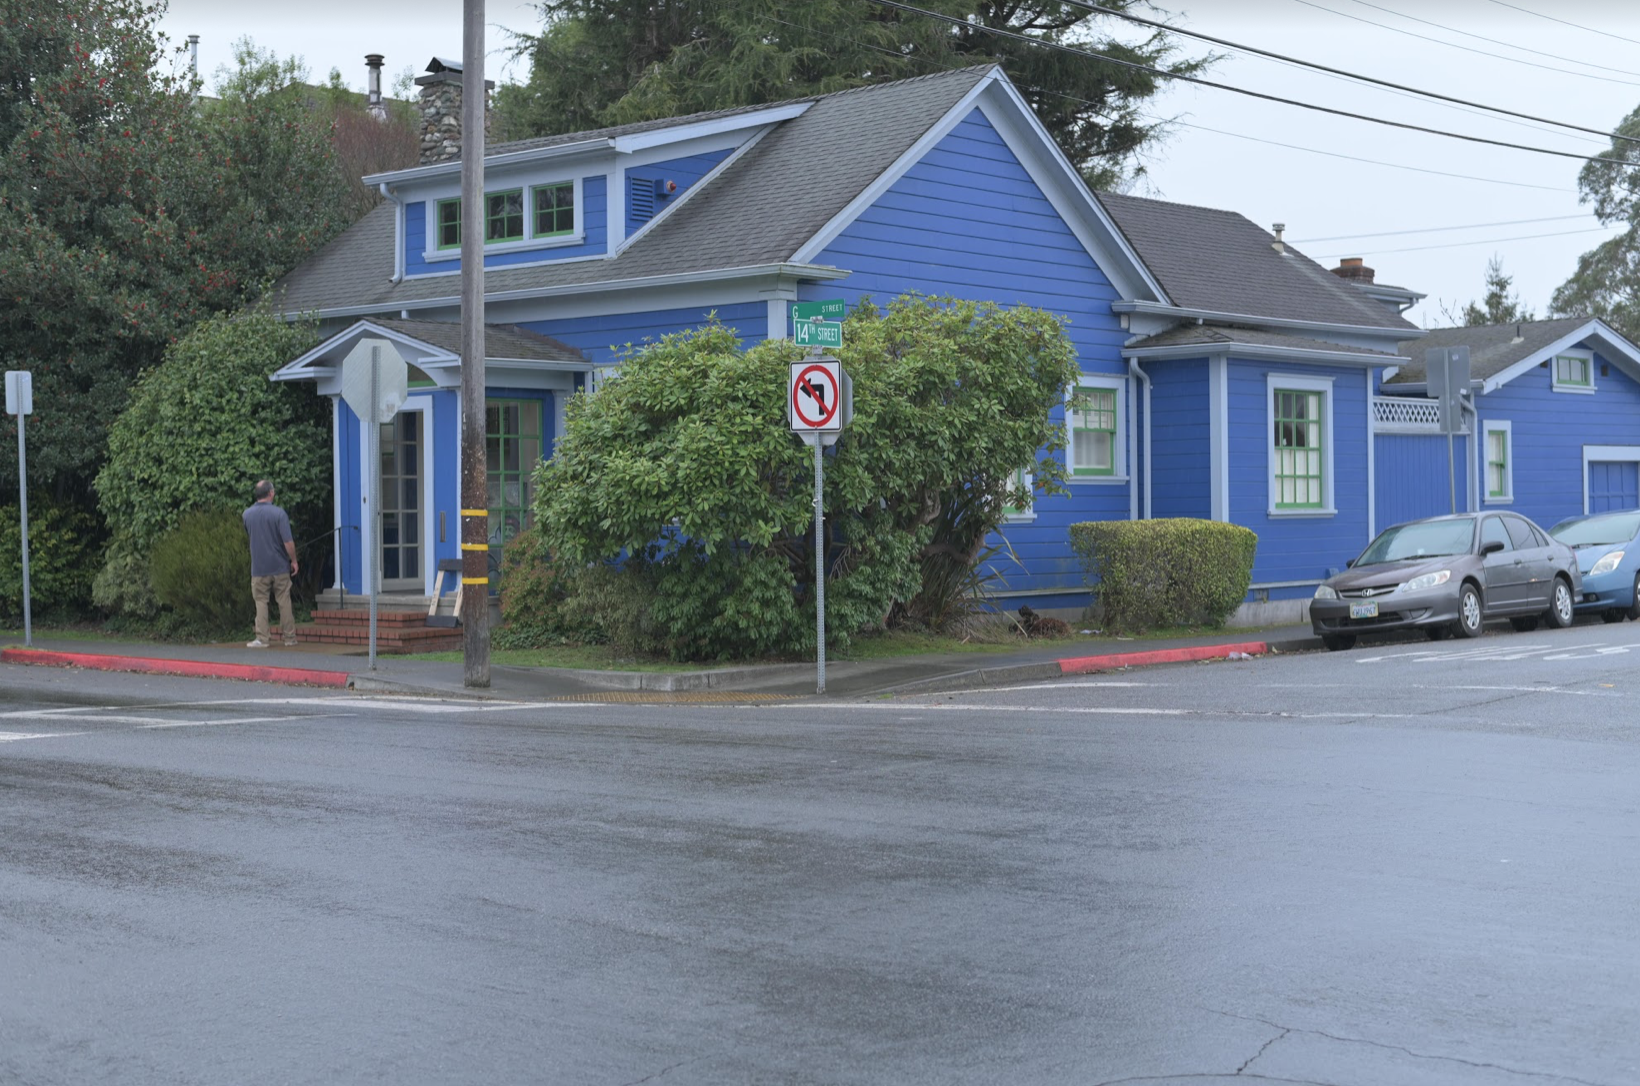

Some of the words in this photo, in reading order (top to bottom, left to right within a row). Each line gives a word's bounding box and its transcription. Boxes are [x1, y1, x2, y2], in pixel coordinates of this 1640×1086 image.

[792, 305, 799, 319] G
[821, 304, 843, 313] STREET
[797, 323, 816, 343] 14TH
[817, 327, 838, 341] STREET
